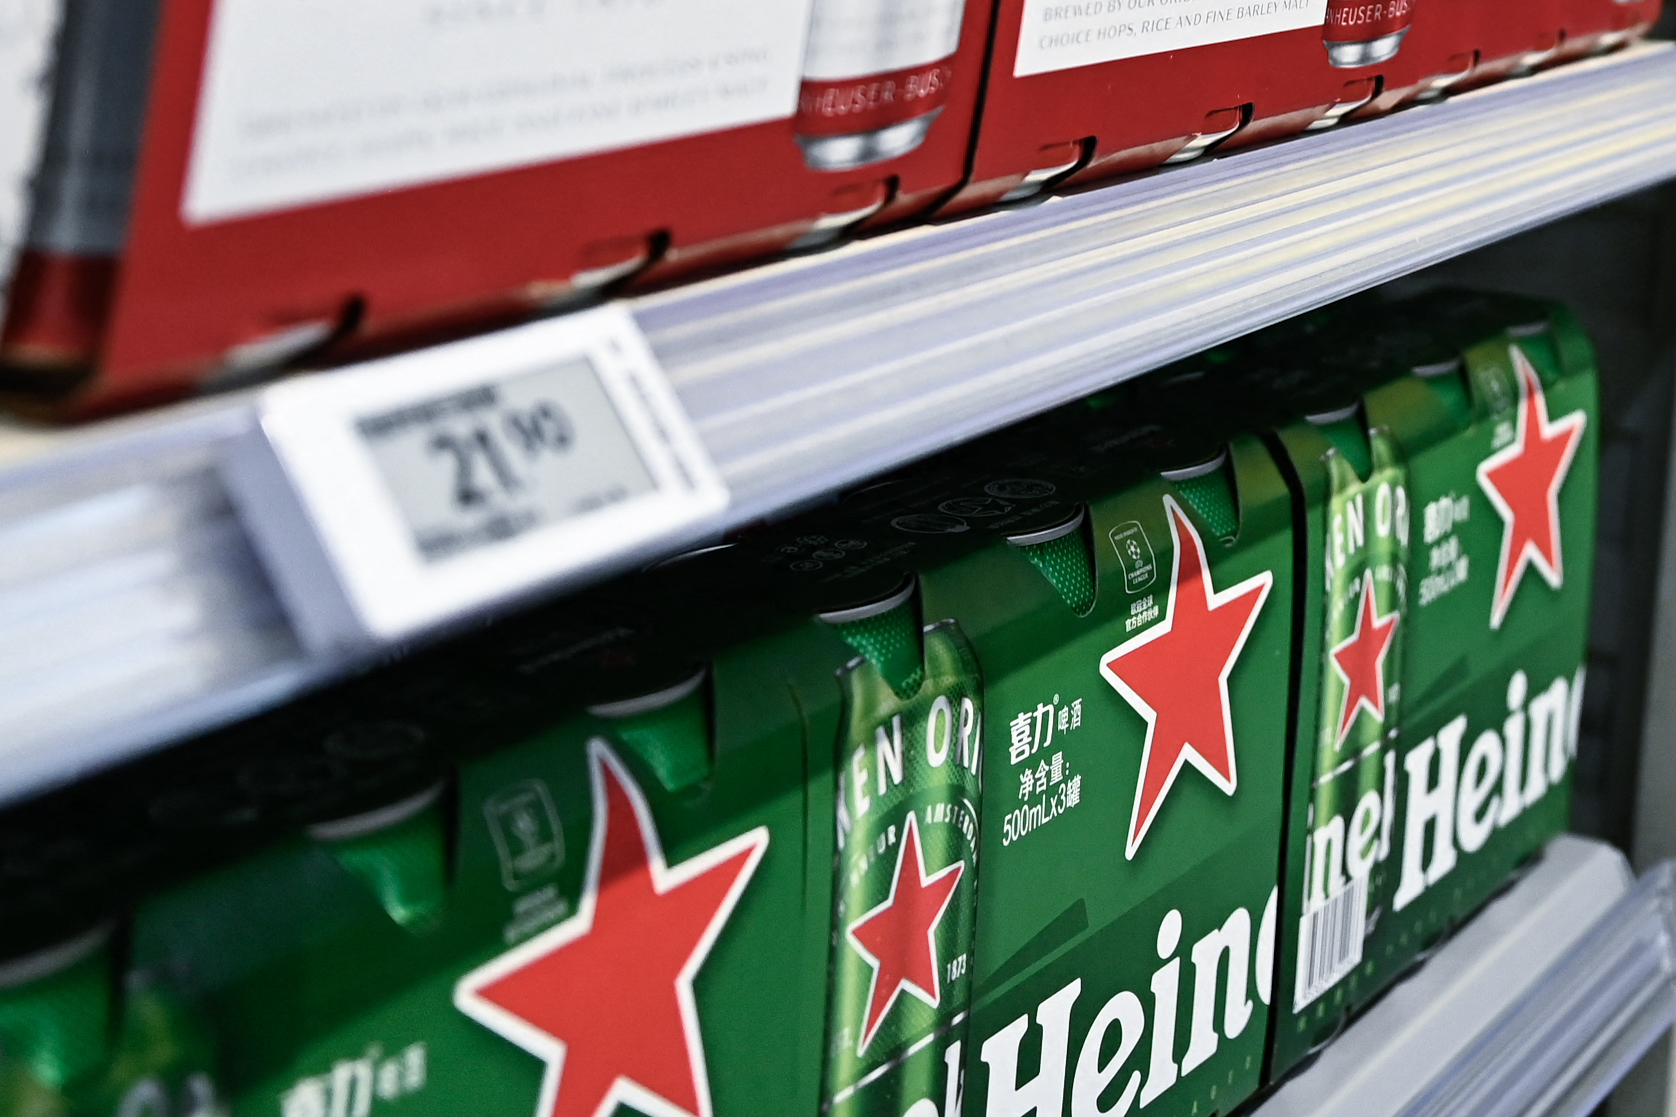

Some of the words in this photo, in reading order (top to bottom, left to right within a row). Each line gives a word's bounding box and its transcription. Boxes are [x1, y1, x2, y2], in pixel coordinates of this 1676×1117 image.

[1038, 28, 1093, 50] CHOICE
[1097, 22, 1137, 41] HOPS,
[1141, 17, 1172, 34] RICE
[1175, 13, 1202, 29] AND
[1205, 8, 1233, 24] FINE
[1236, 1, 1280, 19] BARLEY
[1043, 1, 1103, 22] BREWED
[947, 952, 967, 984] 1873
